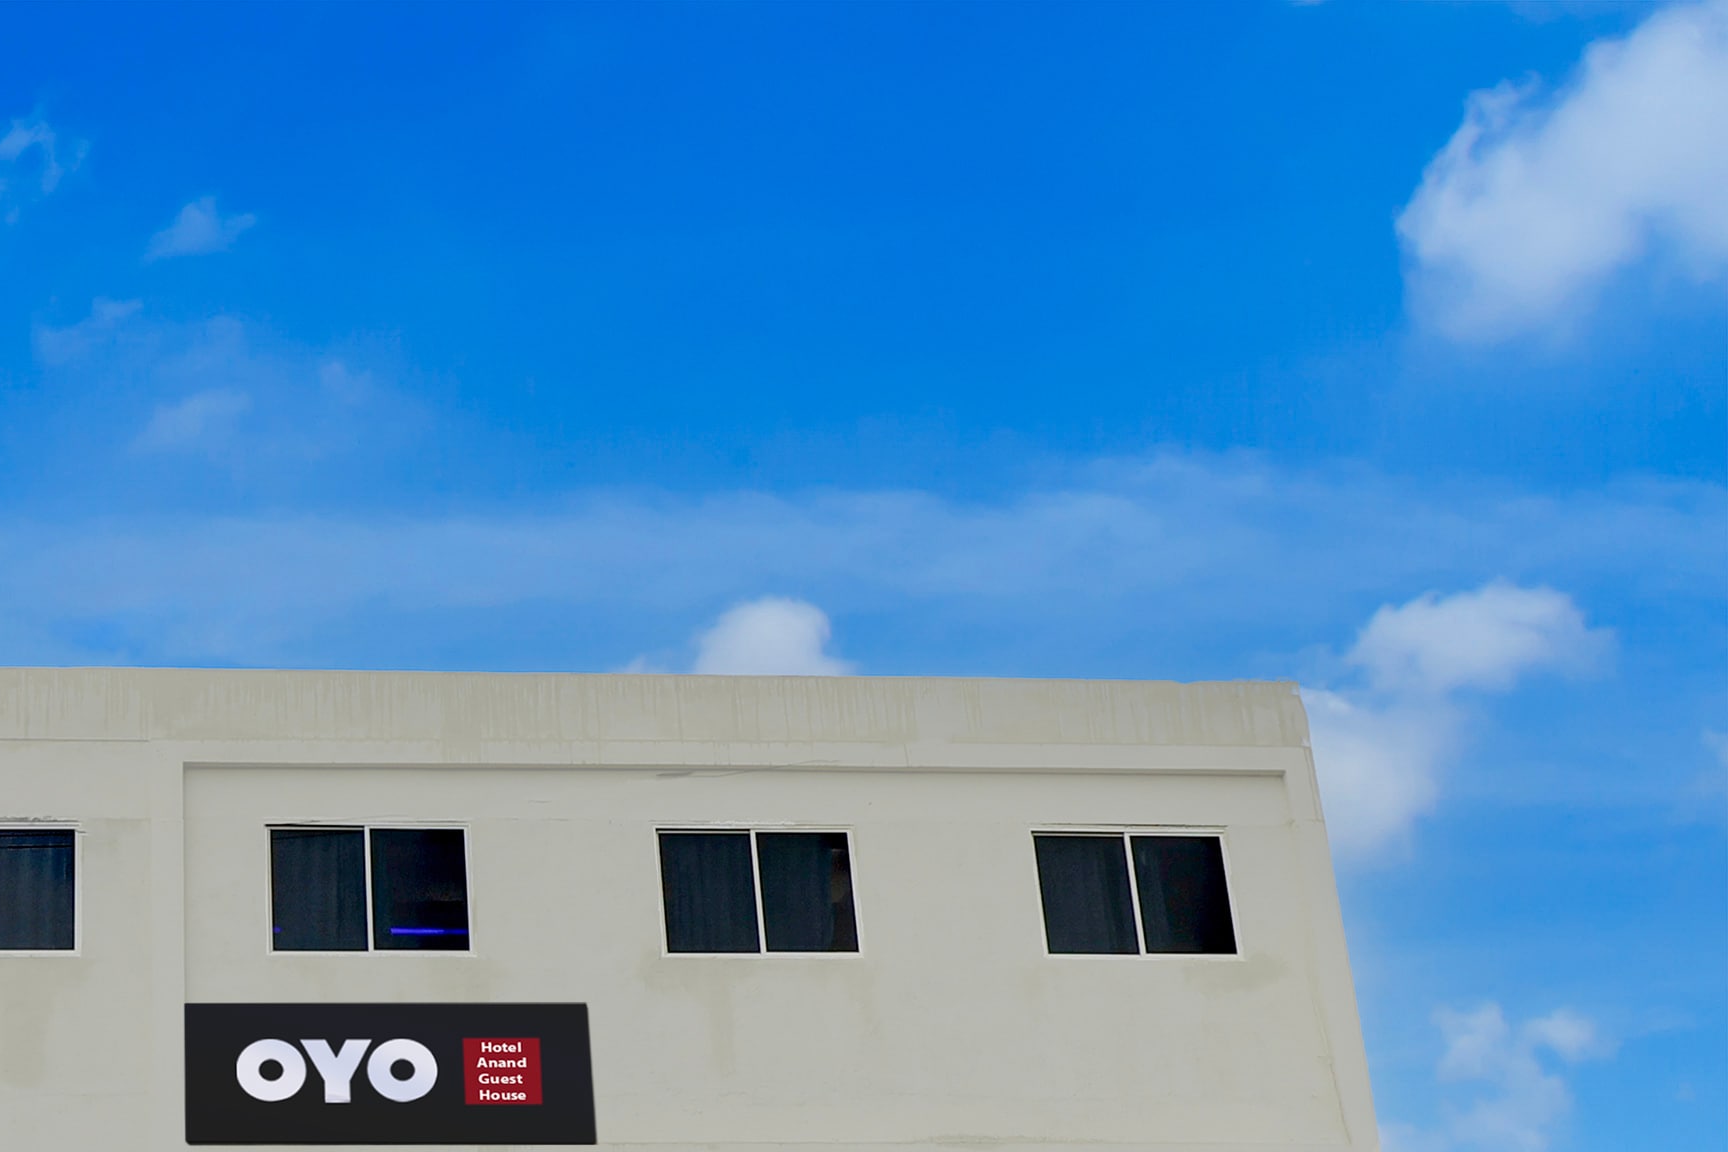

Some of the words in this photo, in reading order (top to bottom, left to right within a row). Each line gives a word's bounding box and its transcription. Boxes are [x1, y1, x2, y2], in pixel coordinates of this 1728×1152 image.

[480, 1041, 522, 1053] Hotel
[477, 1057, 527, 1069] Anand
[236, 1038, 438, 1103] OYO
[478, 1073, 523, 1085] Guest
[479, 1089, 526, 1101] House
